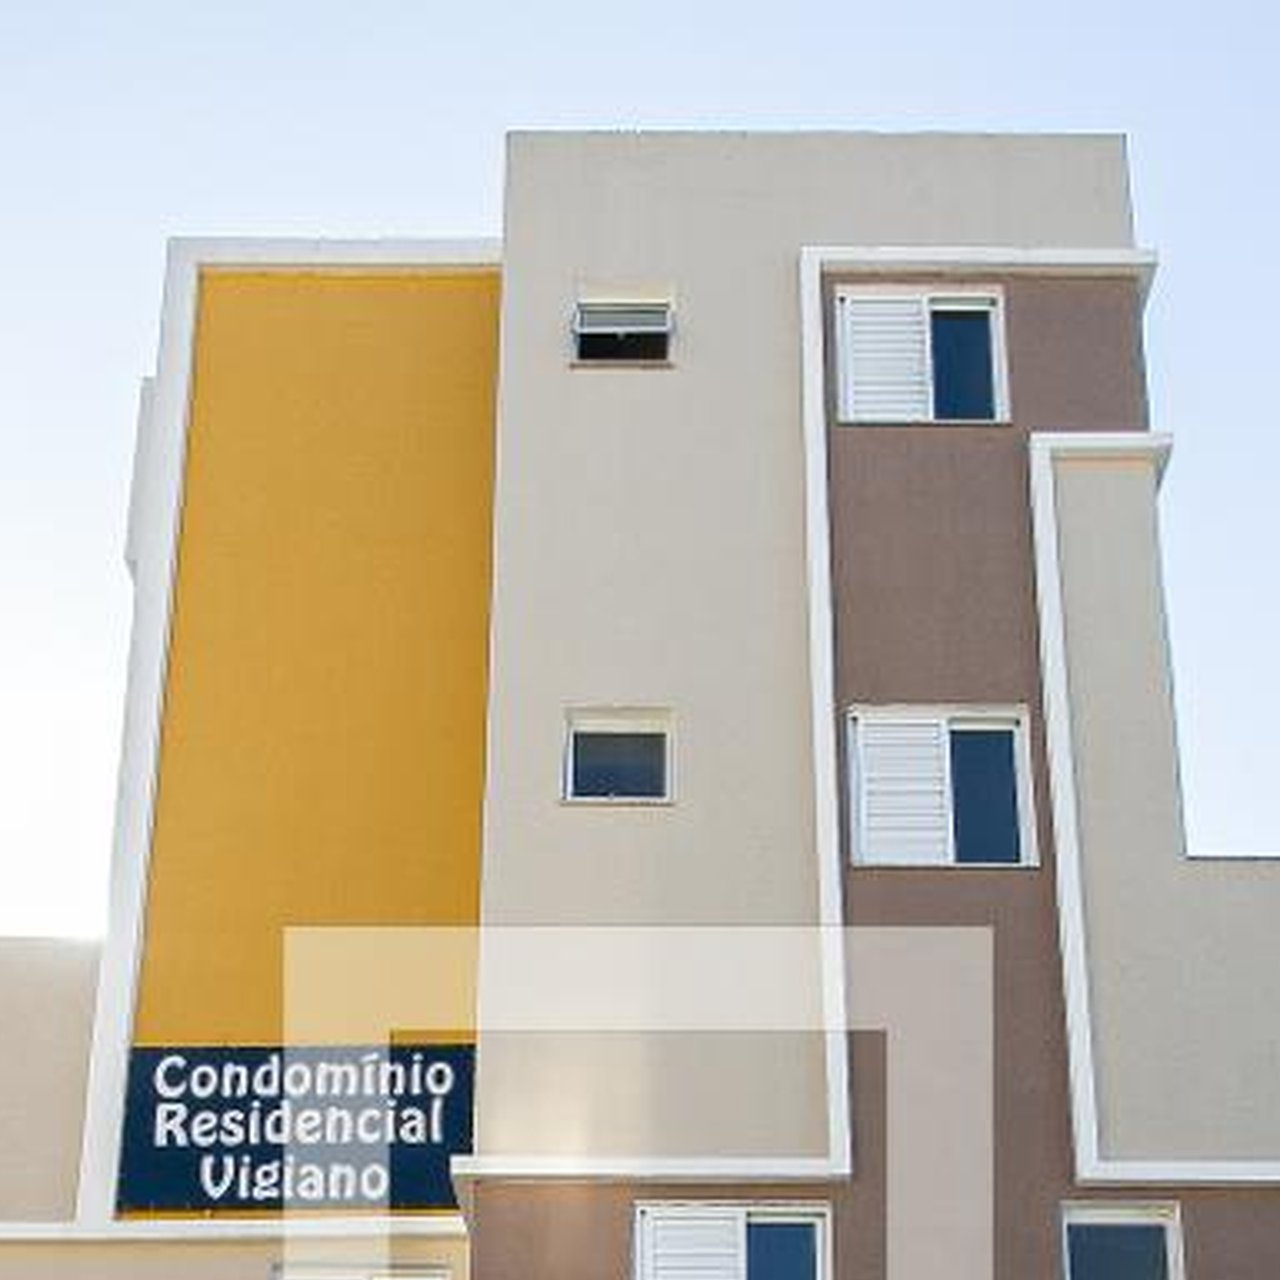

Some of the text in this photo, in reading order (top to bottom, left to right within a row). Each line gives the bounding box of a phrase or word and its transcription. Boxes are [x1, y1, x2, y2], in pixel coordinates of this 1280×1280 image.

[153, 1053, 454, 1098] Condomínio
[154, 1097, 444, 1147] Residencial
[200, 1154, 390, 1201] Vigiano
